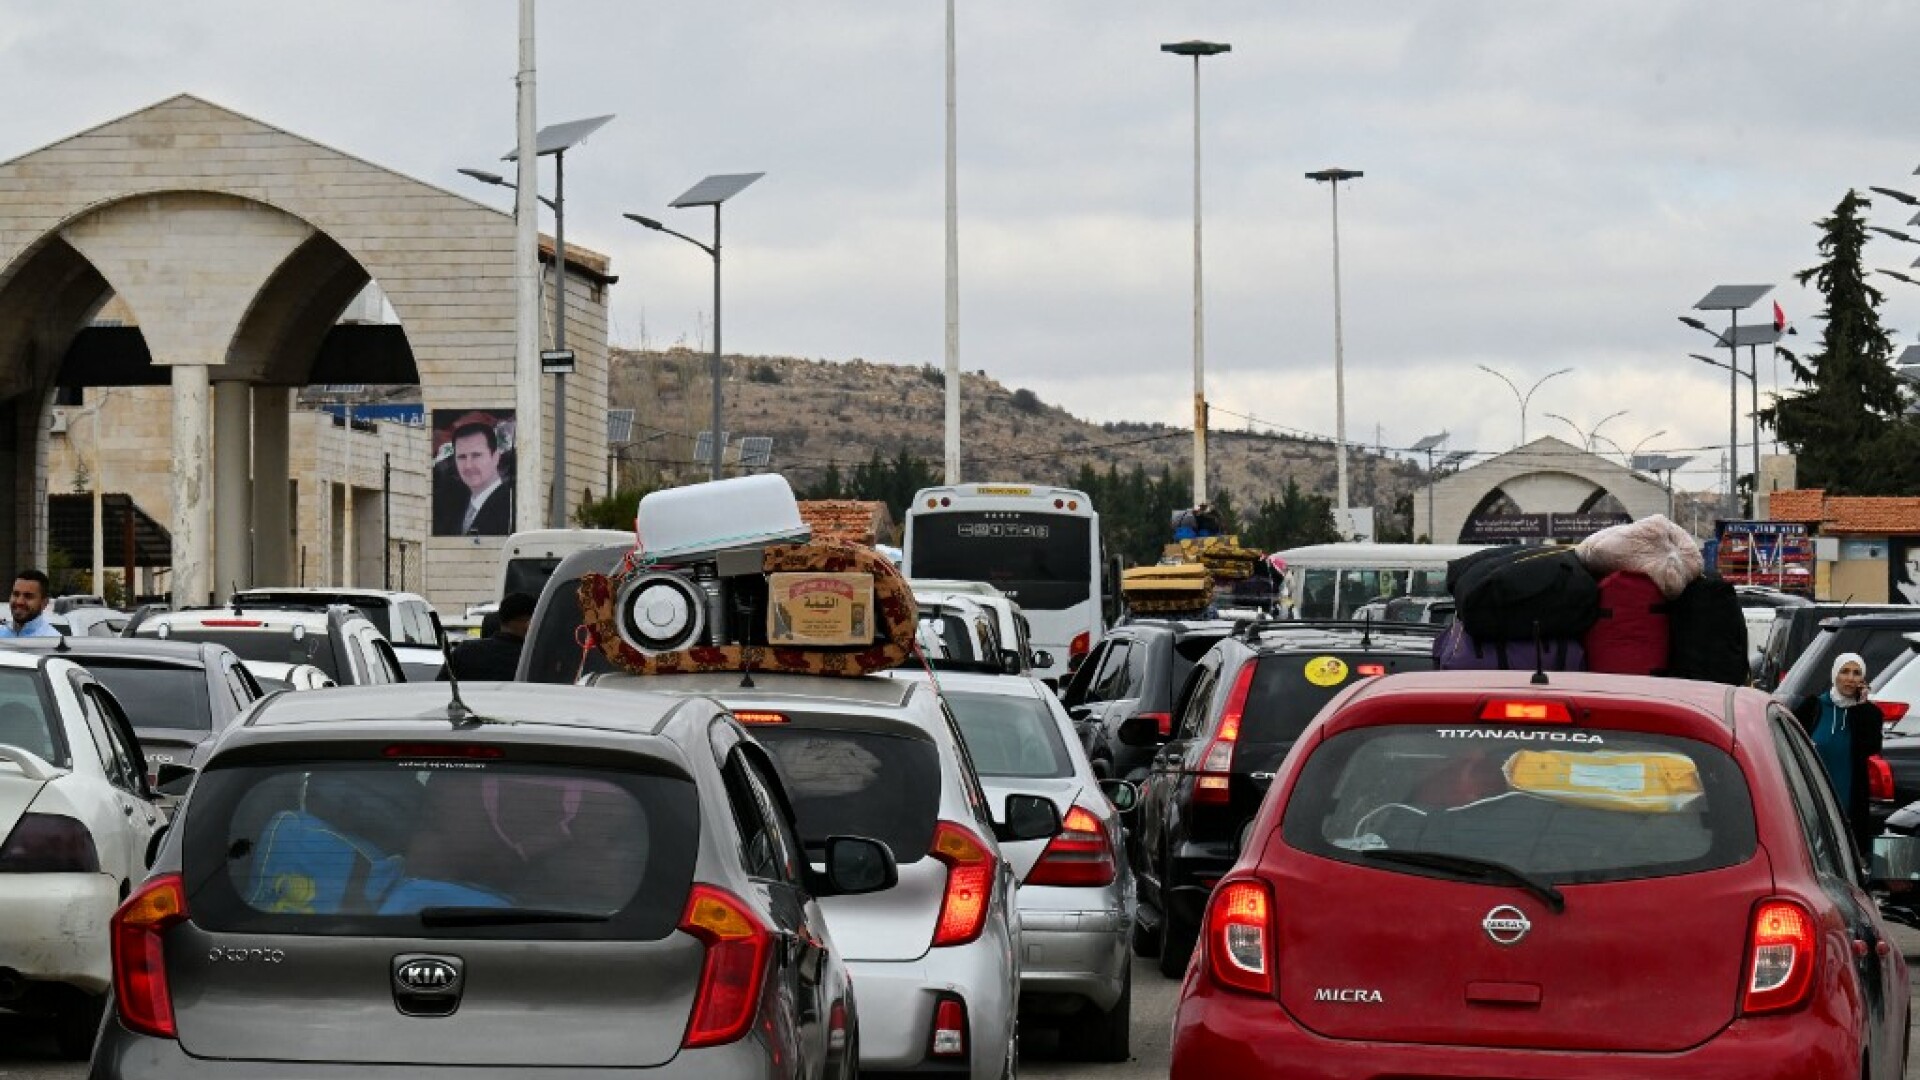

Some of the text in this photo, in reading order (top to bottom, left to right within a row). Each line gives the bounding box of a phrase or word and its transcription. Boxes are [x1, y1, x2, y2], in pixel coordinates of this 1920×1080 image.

[1436, 729, 1603, 744] TITANAUTO.CA
[1250, 771, 1276, 780] CR
[1487, 920, 1526, 929] NISSAN
[408, 967, 447, 984] KIA
[1314, 988, 1383, 1003] MICRA
